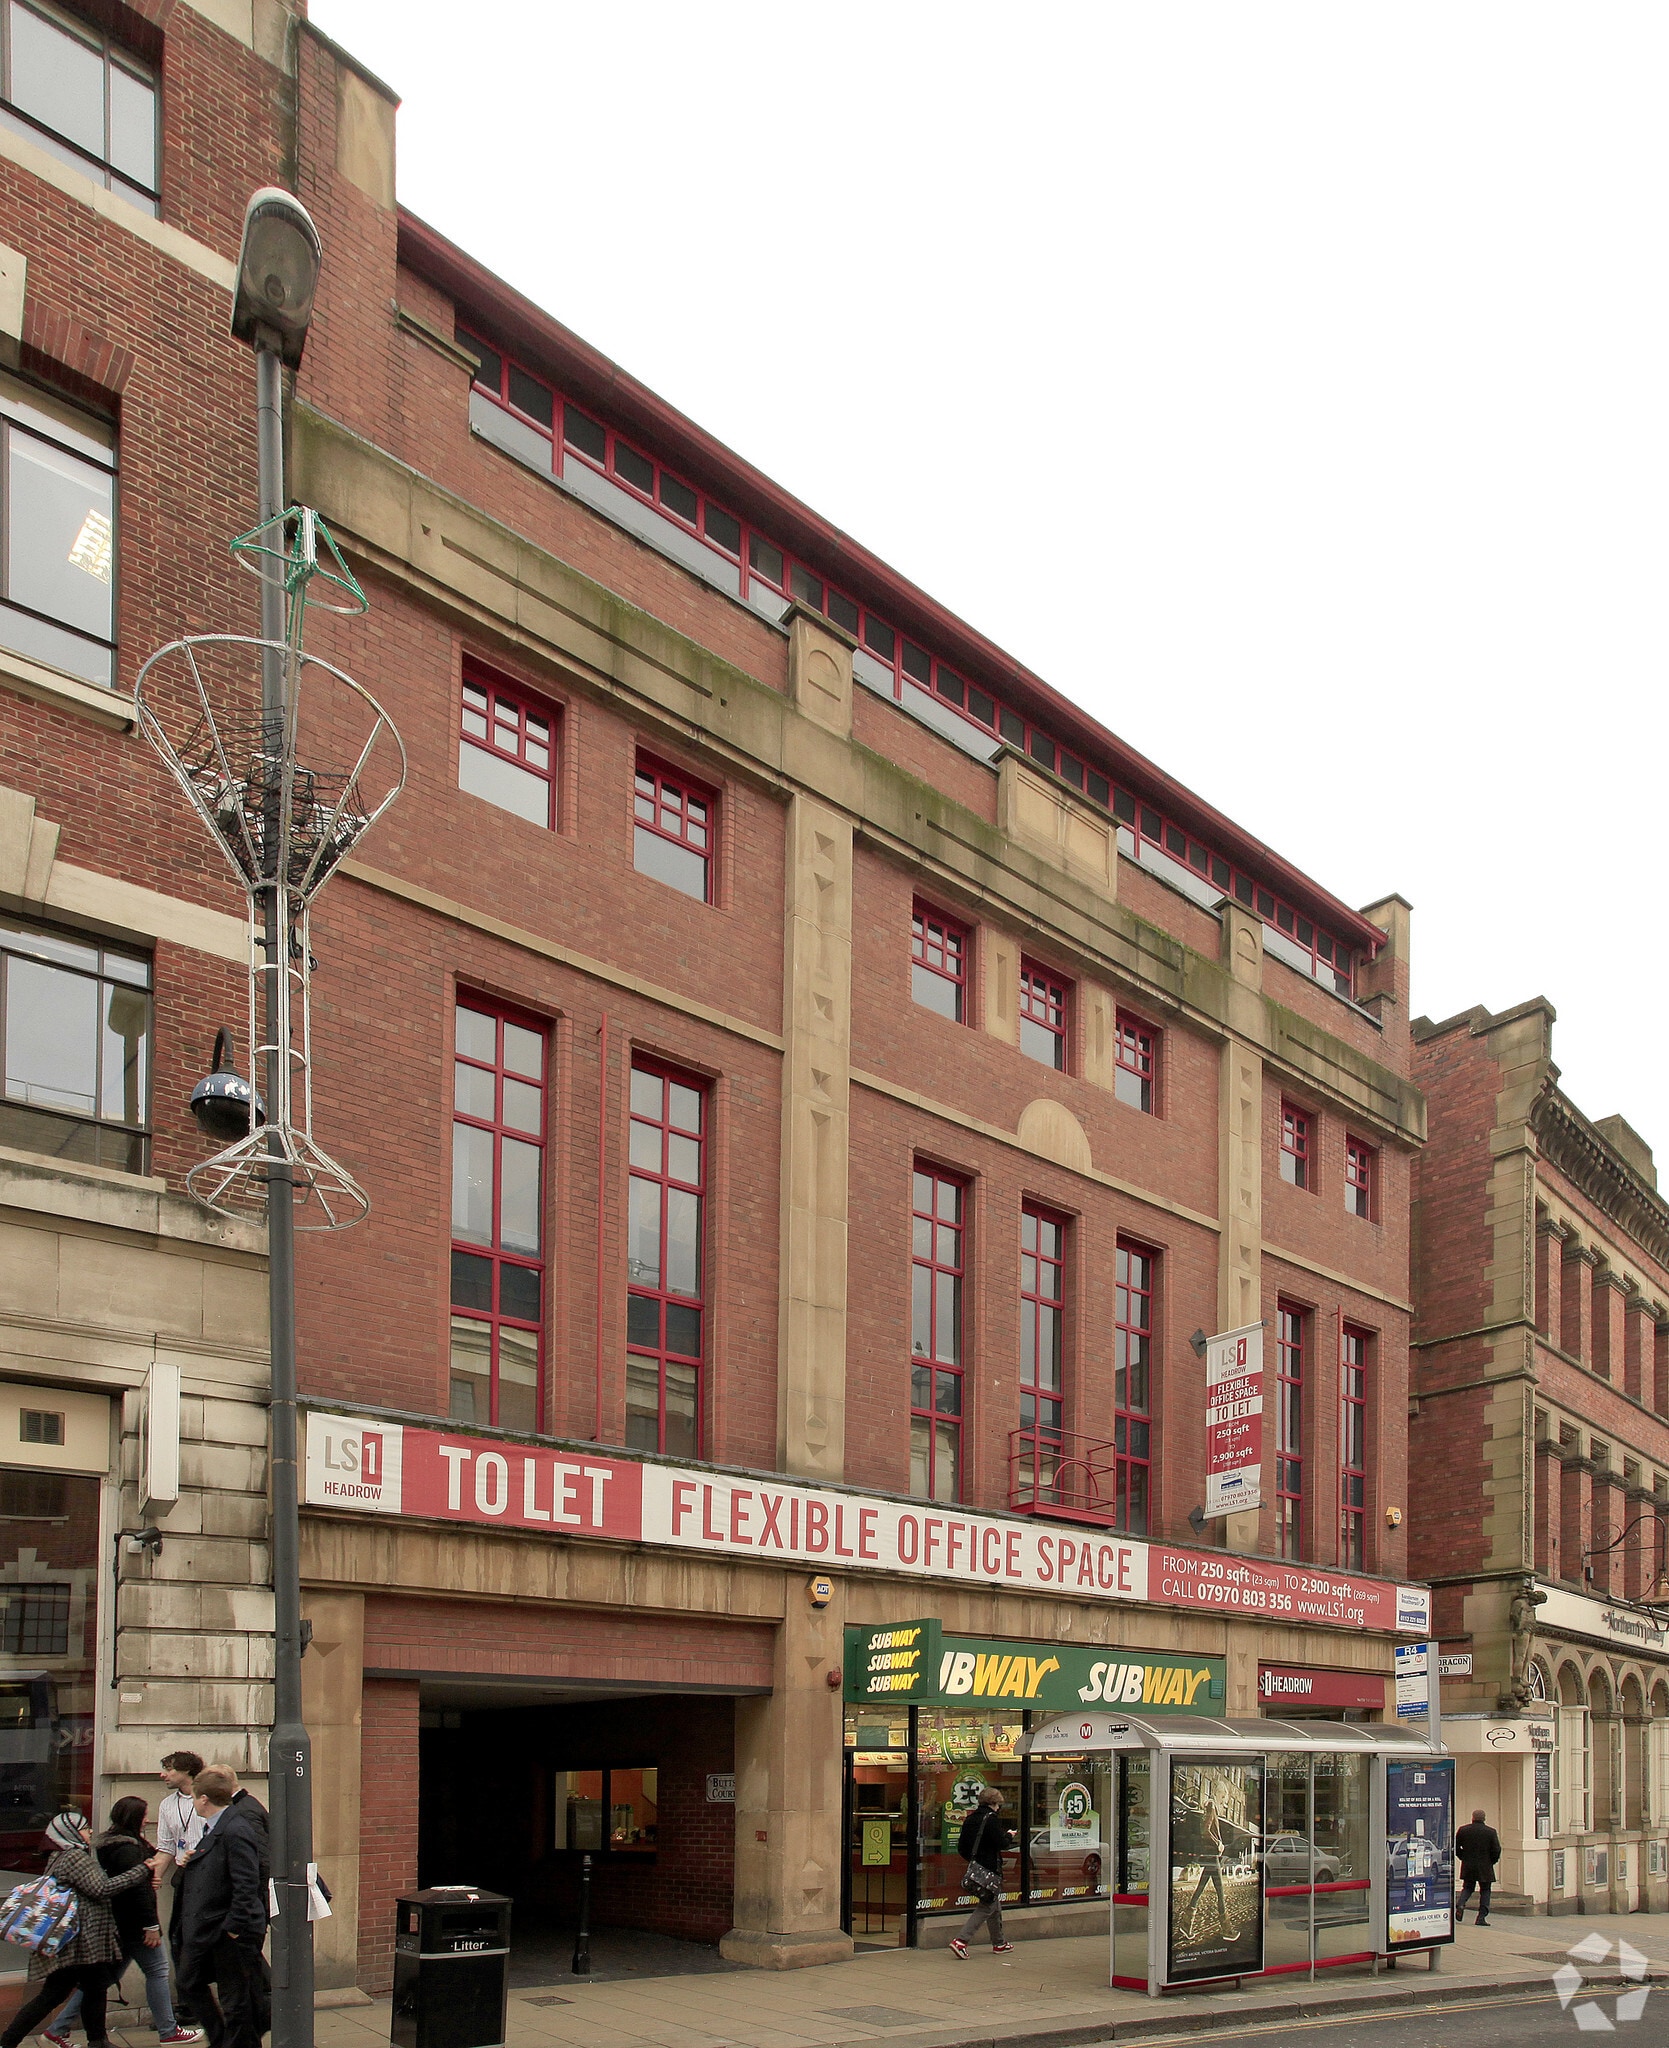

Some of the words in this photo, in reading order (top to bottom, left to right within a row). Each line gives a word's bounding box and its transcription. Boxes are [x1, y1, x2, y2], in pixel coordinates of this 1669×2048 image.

[1222, 1342, 1245, 1366] LS1
[1221, 1366, 1246, 1379] HEADROW
[1210, 1392, 1234, 1406] OFFICE
[1235, 1385, 1259, 1399] SPACE
[1218, 1377, 1250, 1394] FLEXIBLE
[1216, 1406, 1228, 1421] TO
[1232, 1400, 1251, 1417] LET
[1216, 1429, 1231, 1439] 250
[1232, 1424, 1250, 1435] sqft
[325, 1434, 378, 1475] LS1
[1212, 1451, 1234, 1464] 2,900
[1236, 1446, 1253, 1459] sqft
[324, 1481, 382, 1500] HEADROW
[438, 1445, 509, 1517] TO
[523, 1457, 614, 1528] LET
[672, 1480, 879, 1560] FLEXIBLE
[898, 1514, 1022, 1578] OFFICE
[1036, 1535, 1132, 1592] SPACE
[1163, 1556, 1198, 1576] FROM
[1200, 1562, 1224, 1579] 250
[1226, 1566, 1250, 1586] sqft
[1252, 1573, 1263, 1587] (23
[1264, 1576, 1280, 1590] sqm)
[1284, 1574, 1299, 1590] TO
[1301, 1577, 1330, 1595] 2,900
[1331, 1583, 1352, 1600] sqft
[1353, 1589, 1366, 1601] (269
[1366, 1592, 1380, 1605] sqm)
[1162, 1578, 1194, 1599] CALL
[1197, 1582, 1240, 1604] 07970
[1242, 1588, 1267, 1608] 803
[1269, 1592, 1292, 1611] 356
[1297, 1599, 1365, 1625] www.LS1.org
[868, 1628, 921, 1650] SUBWAY
[867, 1650, 921, 1671] SUBWAY
[1404, 1646, 1418, 1655] R4
[867, 1672, 920, 1693] SUBWAY
[1078, 1662, 1211, 1705] SUBWAY
[1272, 1676, 1313, 1694] HEADROW
[1067, 1794, 1083, 1814] £5
[870, 1827, 884, 1844] Q
[1226, 1864, 1252, 1881] UGG
[1029, 1888, 1056, 1899] SUBWAY
[1062, 1886, 1089, 1896] SUBWAY
[916, 1898, 948, 1909] SUBWAY
[454, 1941, 485, 1951] Litter
